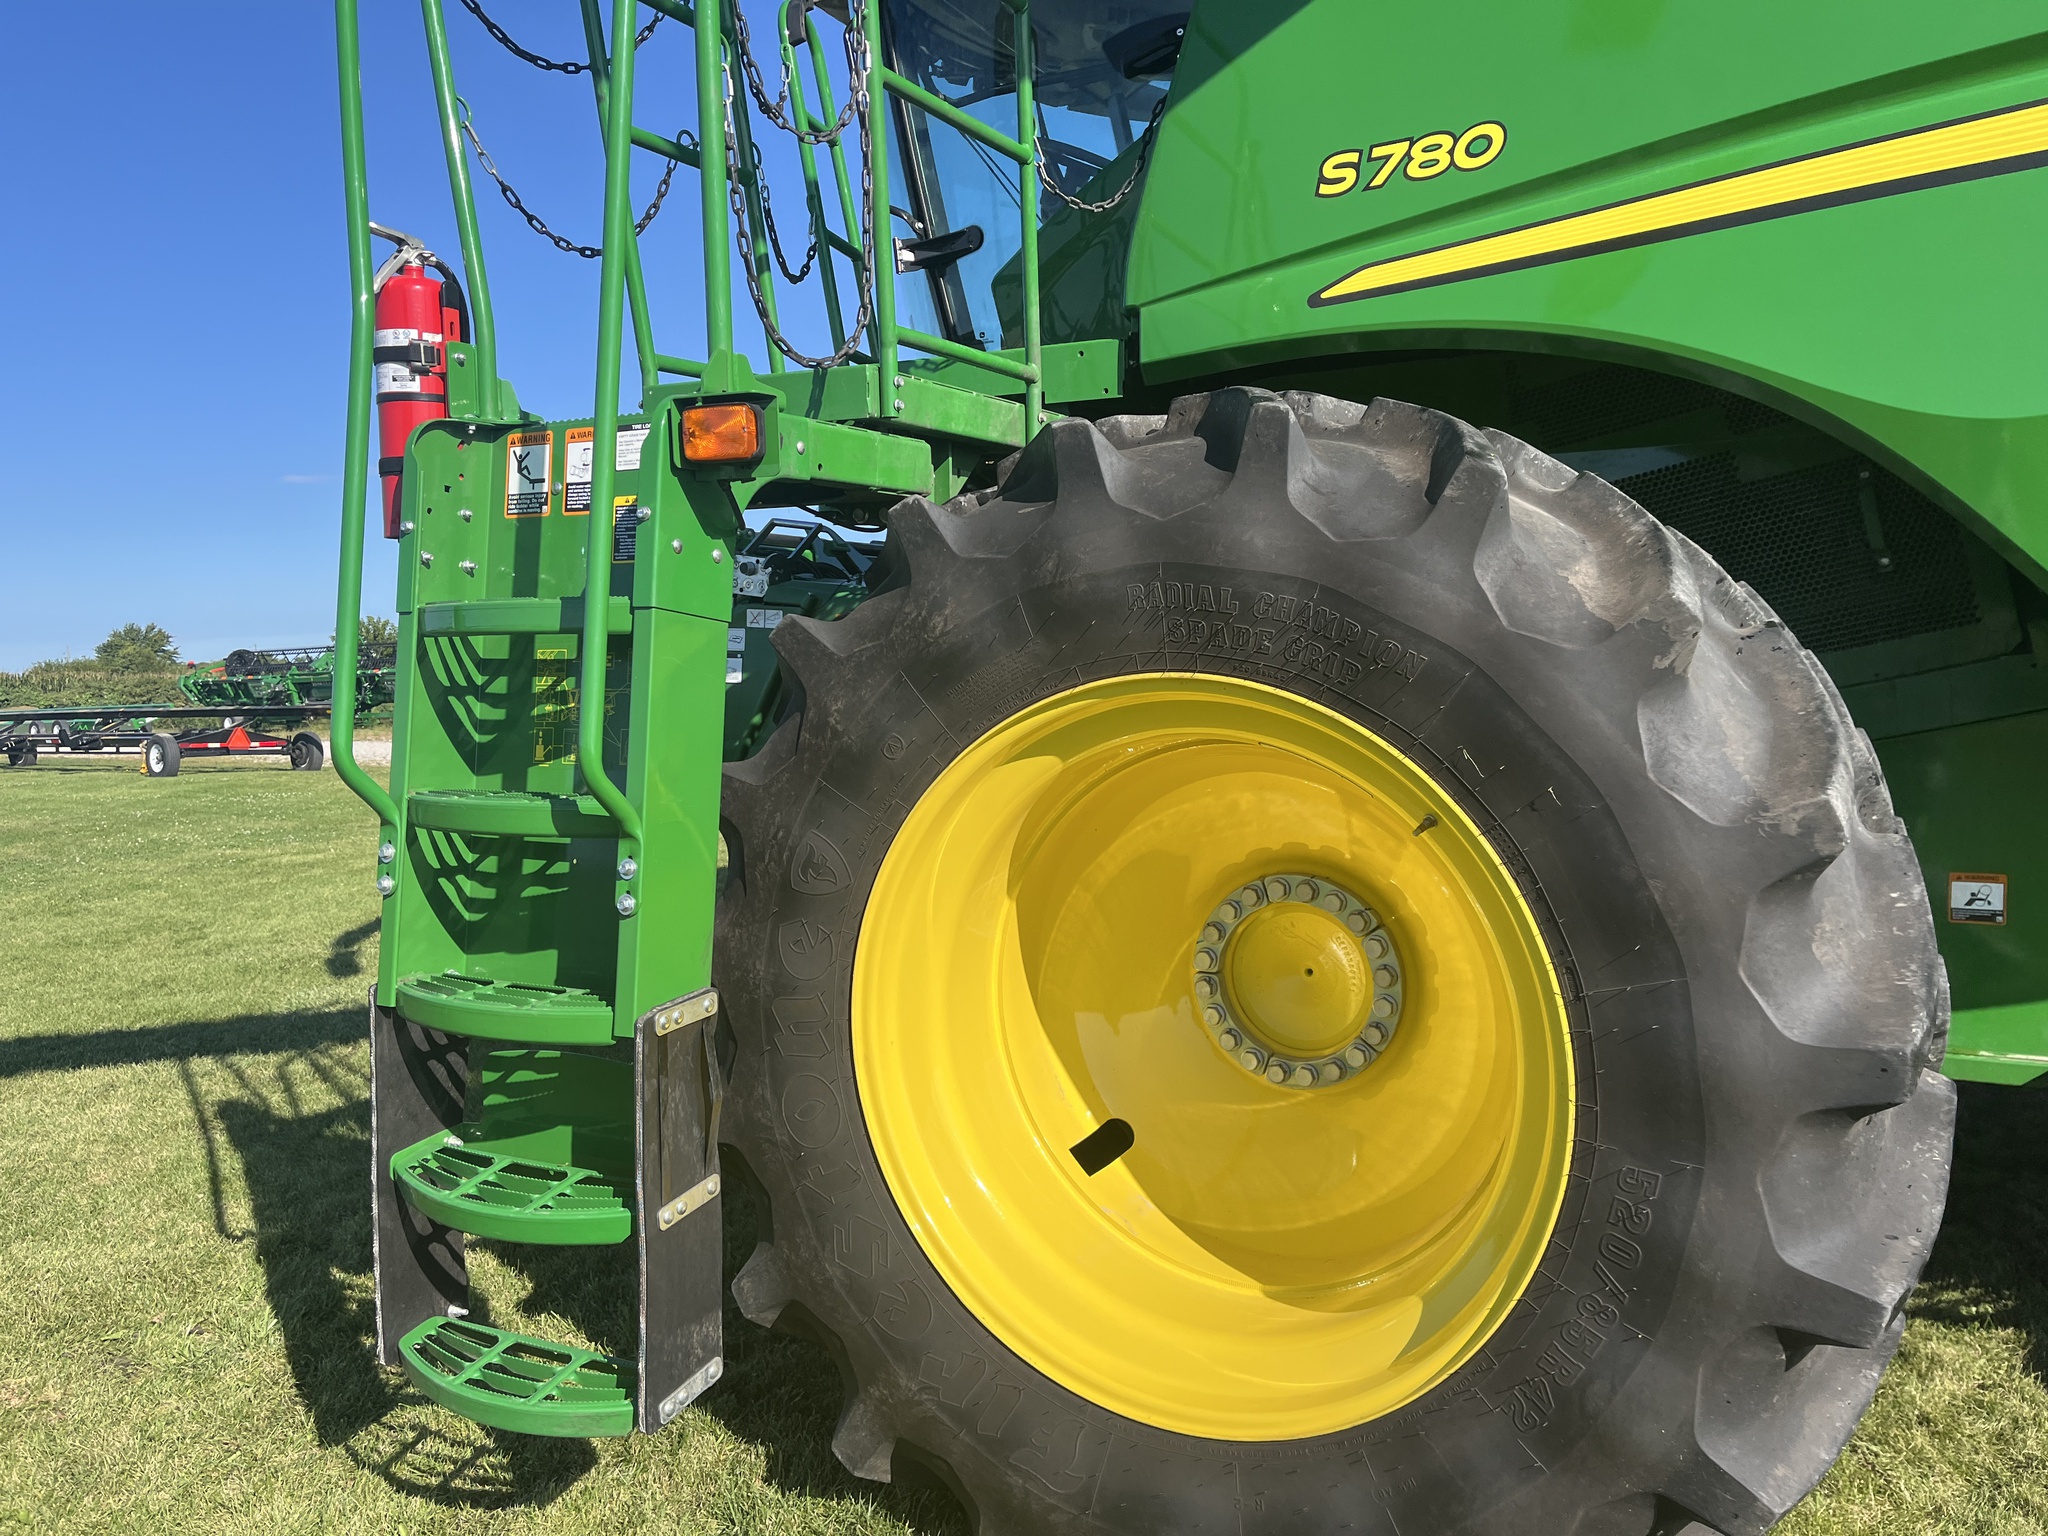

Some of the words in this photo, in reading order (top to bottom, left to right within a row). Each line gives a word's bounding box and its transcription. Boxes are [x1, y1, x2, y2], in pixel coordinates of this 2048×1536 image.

[1314, 119, 1508, 198] S780
[517, 433, 551, 444] WARNING
[1126, 581, 1239, 615] RADIAL
[1252, 591, 1428, 682] CHAMPION
[1165, 616, 1275, 655] SPADE
[1283, 633, 1363, 686] GRIP
[1500, 1164, 1663, 1434] 520/85R42
